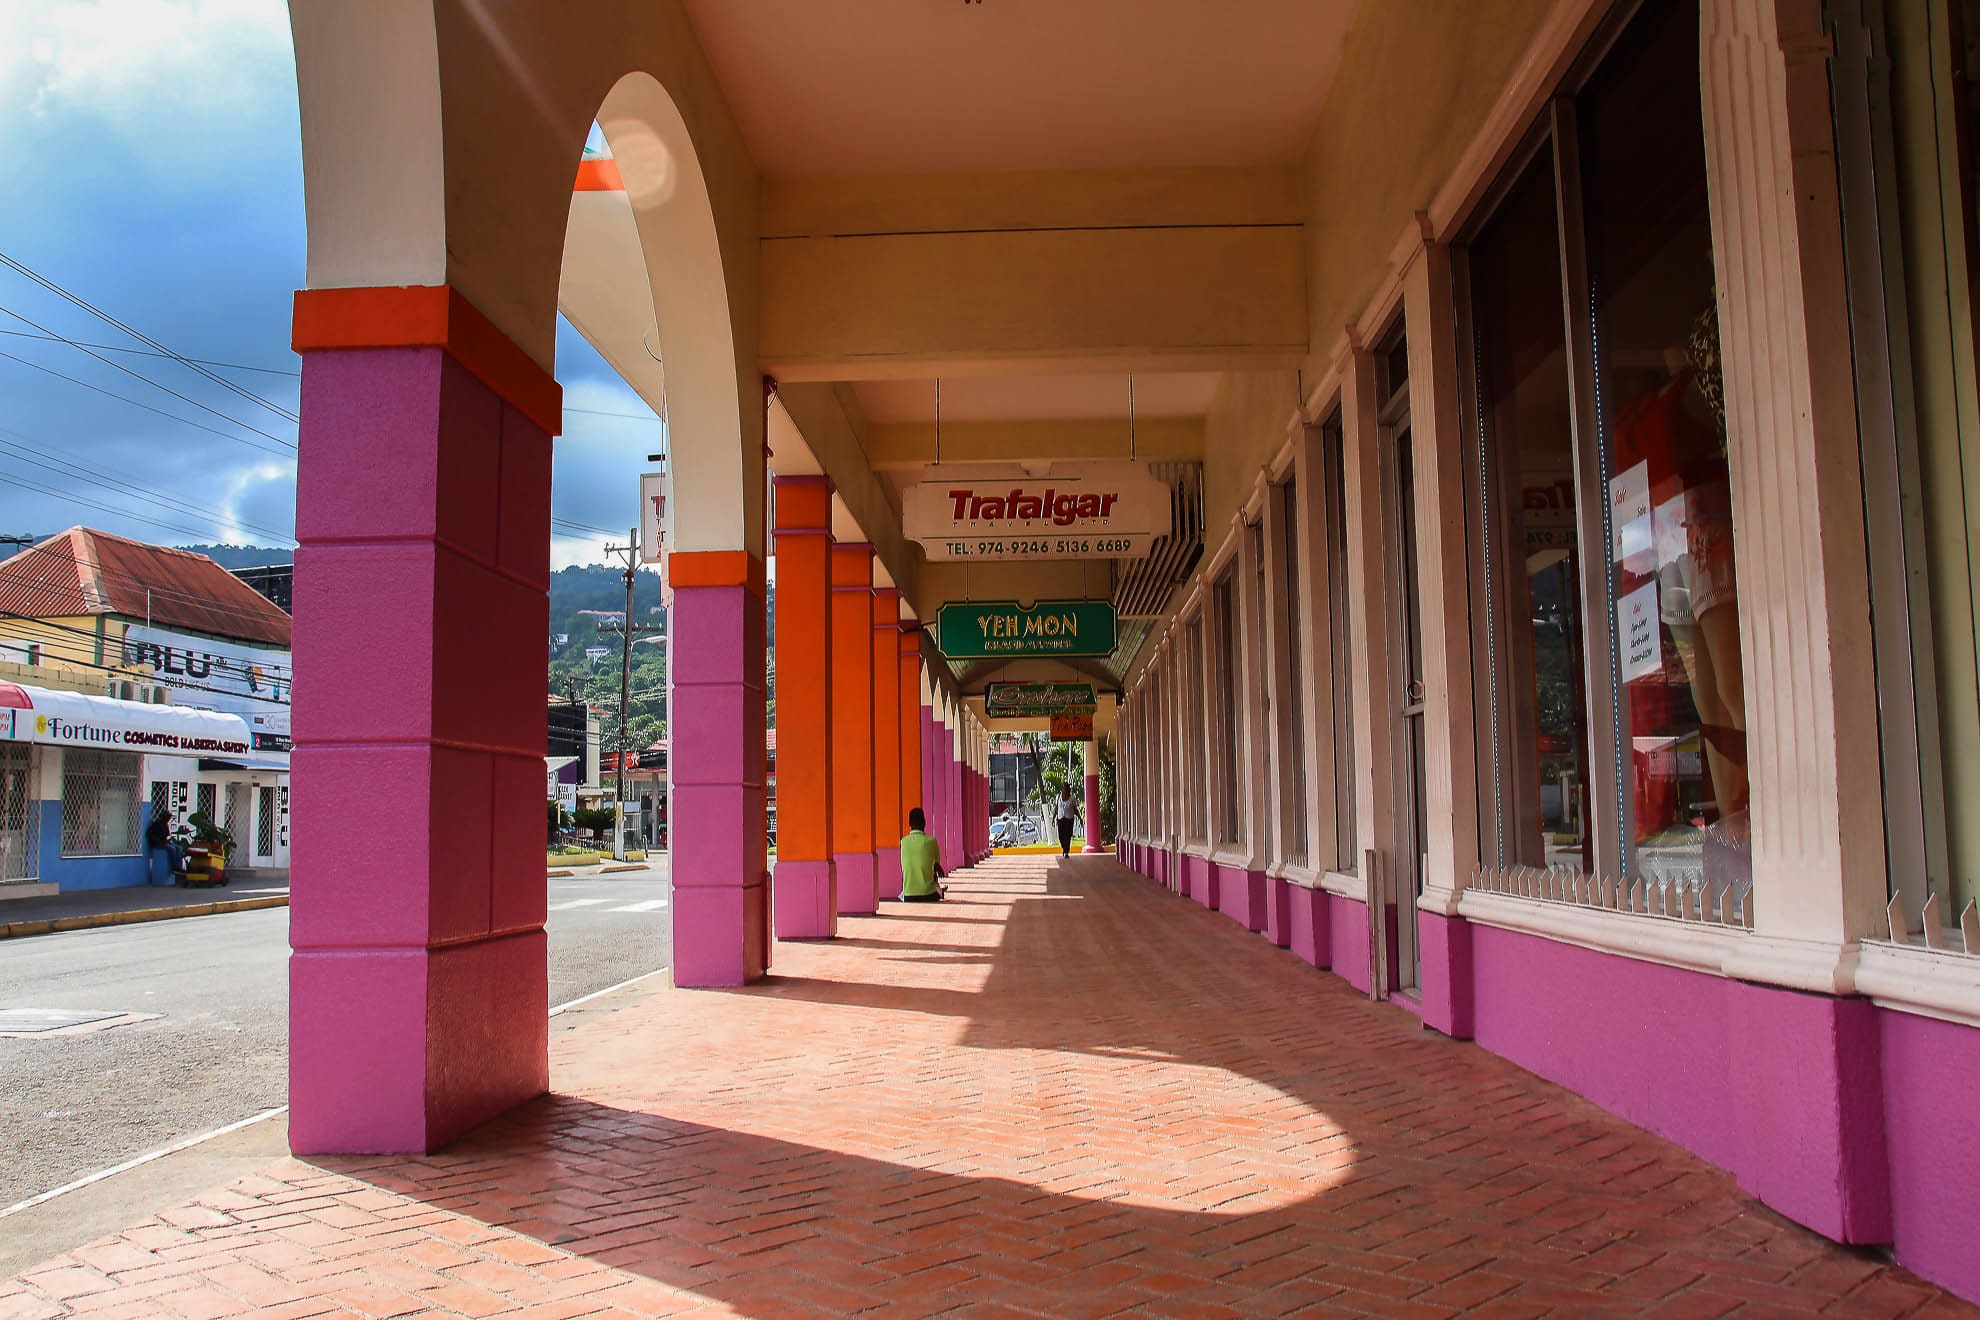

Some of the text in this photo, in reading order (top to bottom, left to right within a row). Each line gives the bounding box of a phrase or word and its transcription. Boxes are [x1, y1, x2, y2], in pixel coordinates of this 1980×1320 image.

[948, 488, 1119, 526] Trafalgar
[946, 542, 974, 555] TEL:
[977, 612, 1077, 638] YEH MON
[136, 641, 211, 679] BLU
[164, 676, 184, 688] BOLD
[47, 717, 250, 754] Fortune COSMETICS HABERDASHERY
[280, 786, 289, 847] BLU
